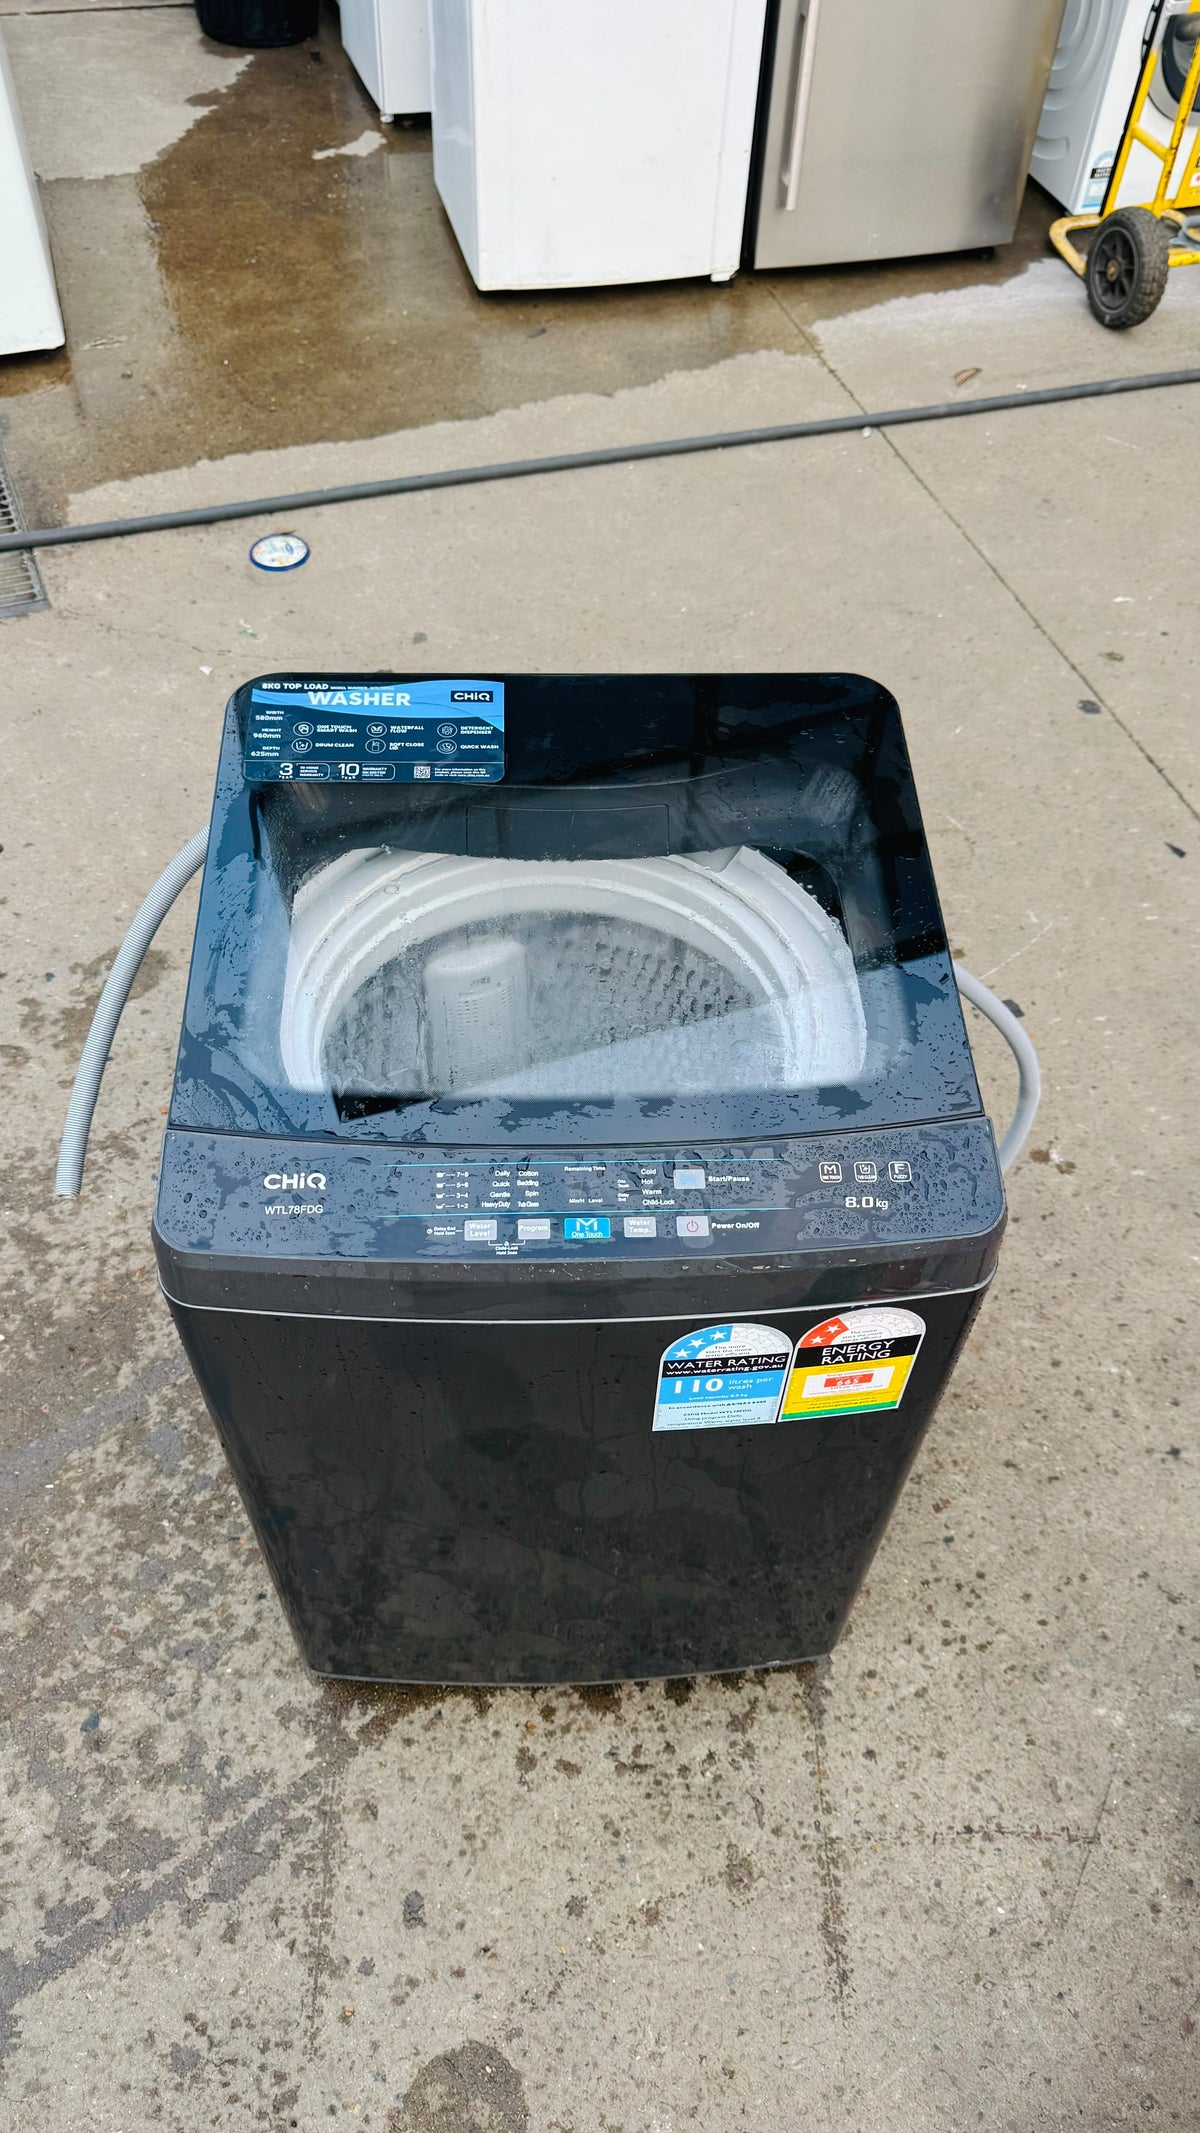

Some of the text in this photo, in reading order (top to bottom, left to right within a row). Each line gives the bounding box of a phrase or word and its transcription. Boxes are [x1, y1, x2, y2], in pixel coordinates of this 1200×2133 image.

[308, 692, 411, 706] WASHER
[280, 763, 293, 776] 3
[338, 763, 360, 776] 10
[894, 1164, 904, 1174] F
[265, 1205, 324, 1215] WTL78FDG
[845, 1197, 888, 1210] 8.0 kg
[822, 1340, 895, 1356] ENERGY
[667, 1356, 786, 1369] WATER RATING
[821, 1350, 890, 1365] RATING
[666, 1364, 783, 1375] www.waterrating.gov.au
[674, 1378, 723, 1394] 110
